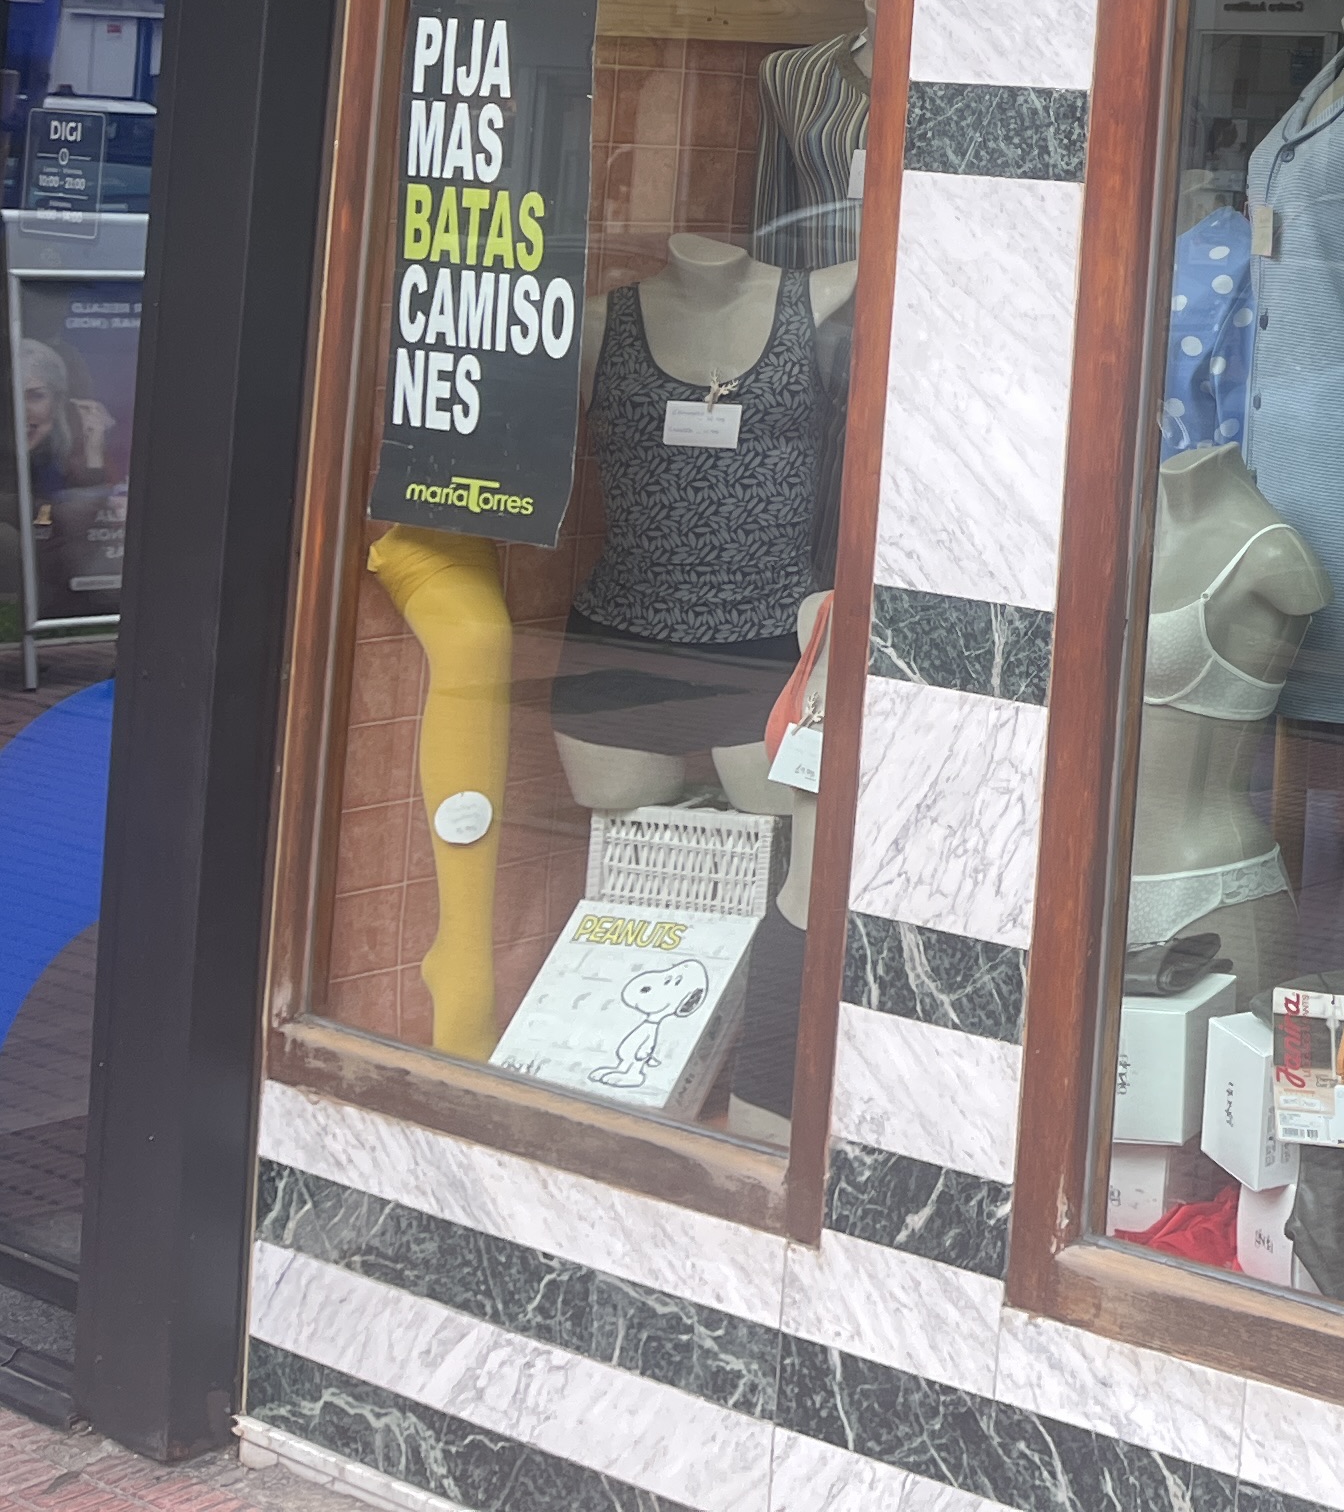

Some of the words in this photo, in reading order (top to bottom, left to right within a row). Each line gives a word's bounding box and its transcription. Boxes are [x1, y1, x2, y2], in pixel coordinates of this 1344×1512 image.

[412, 17, 511, 98] PIJA
[50, 120, 82, 142] DIGI
[407, 100, 504, 183] MAS
[403, 183, 545, 271] BATAS
[399, 264, 575, 359] CAMISO
[392, 347, 482, 435] NES
[571, 914, 689, 951] PEANUTS
[1276, 993, 1306, 1088] Janira
